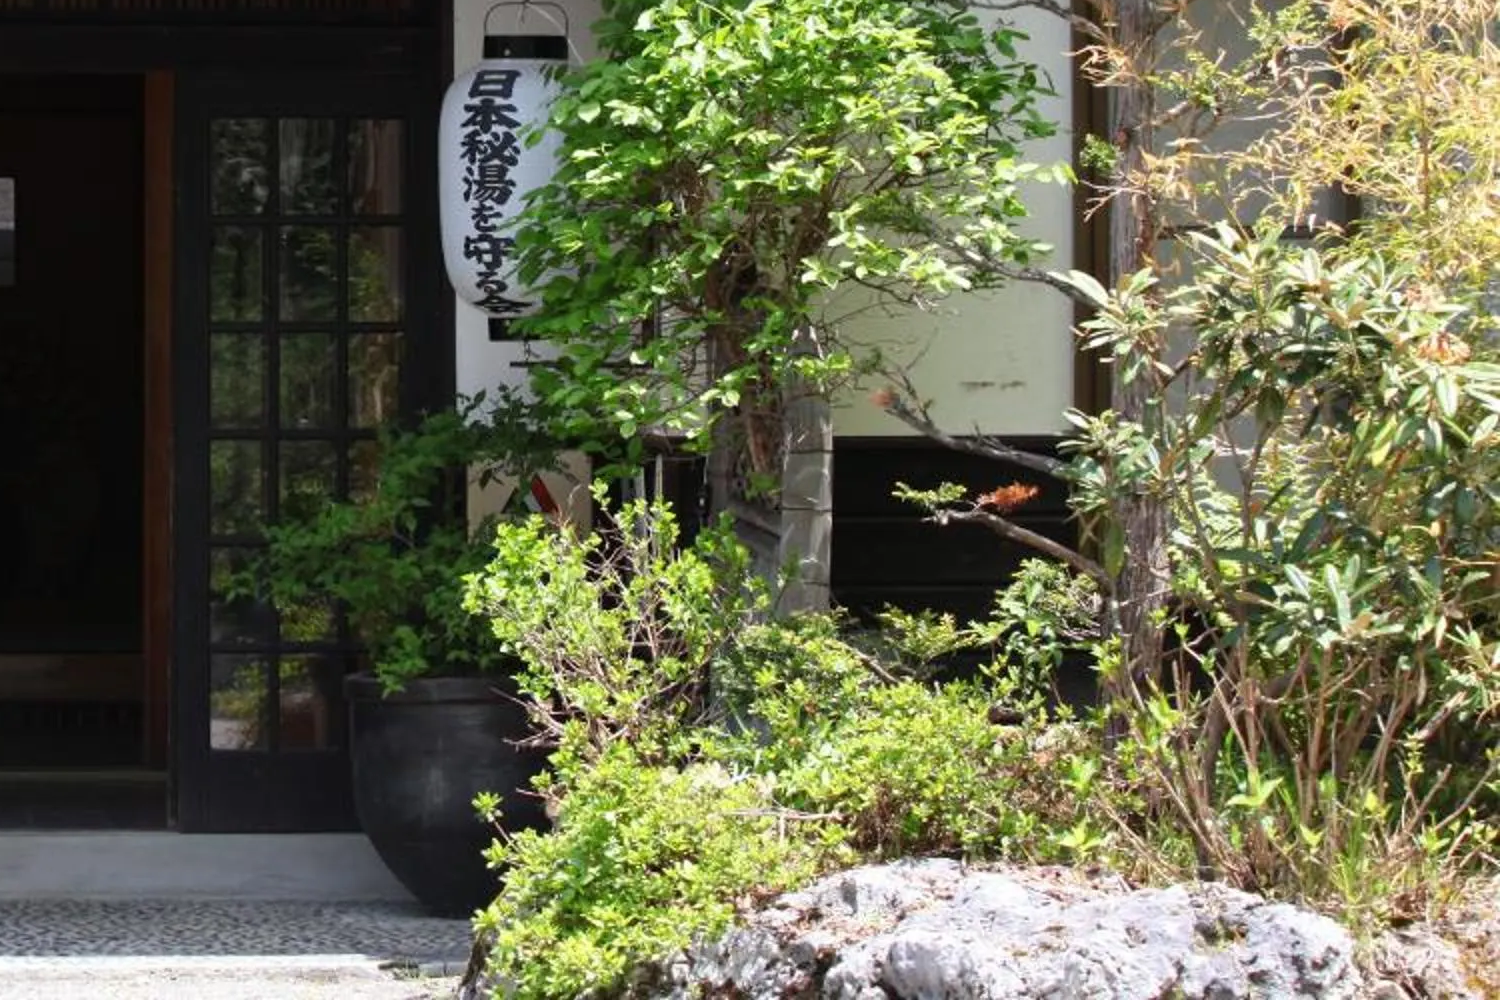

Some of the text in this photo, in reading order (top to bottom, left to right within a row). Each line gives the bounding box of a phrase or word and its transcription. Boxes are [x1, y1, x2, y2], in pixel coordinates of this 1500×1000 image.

[460, 69, 533, 314] 日本秘湯を守る会
